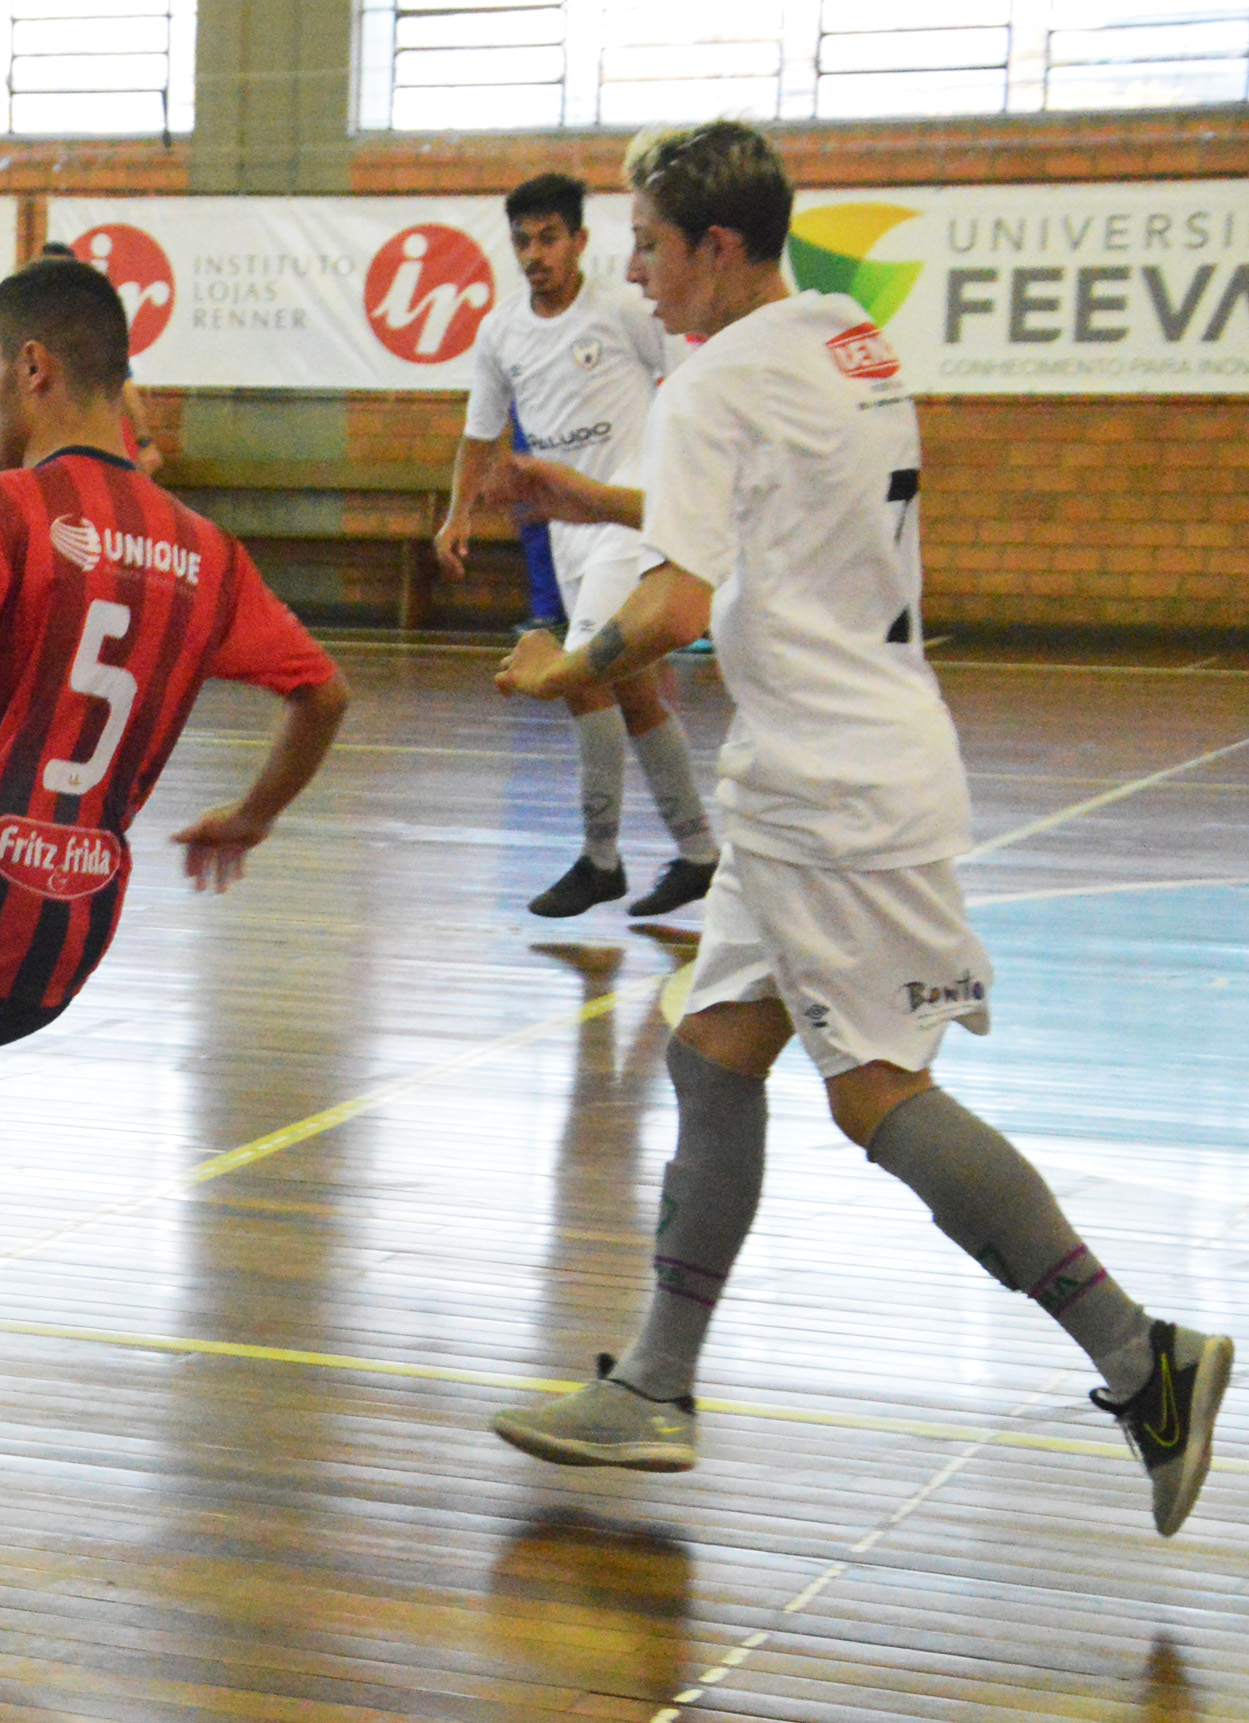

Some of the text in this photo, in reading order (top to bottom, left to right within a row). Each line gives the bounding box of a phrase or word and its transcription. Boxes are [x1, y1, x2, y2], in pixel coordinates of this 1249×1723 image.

[948, 211, 1236, 253] UNIVERSI
[193, 254, 355, 276] INSTITUTO
[193, 280, 279, 304] LOJAS
[371, 232, 490, 354] ir
[193, 307, 308, 329] RENNER
[103, 528, 202, 585] UNIQUE
[42, 598, 138, 796] 5
[62, 835, 111, 876] frida
